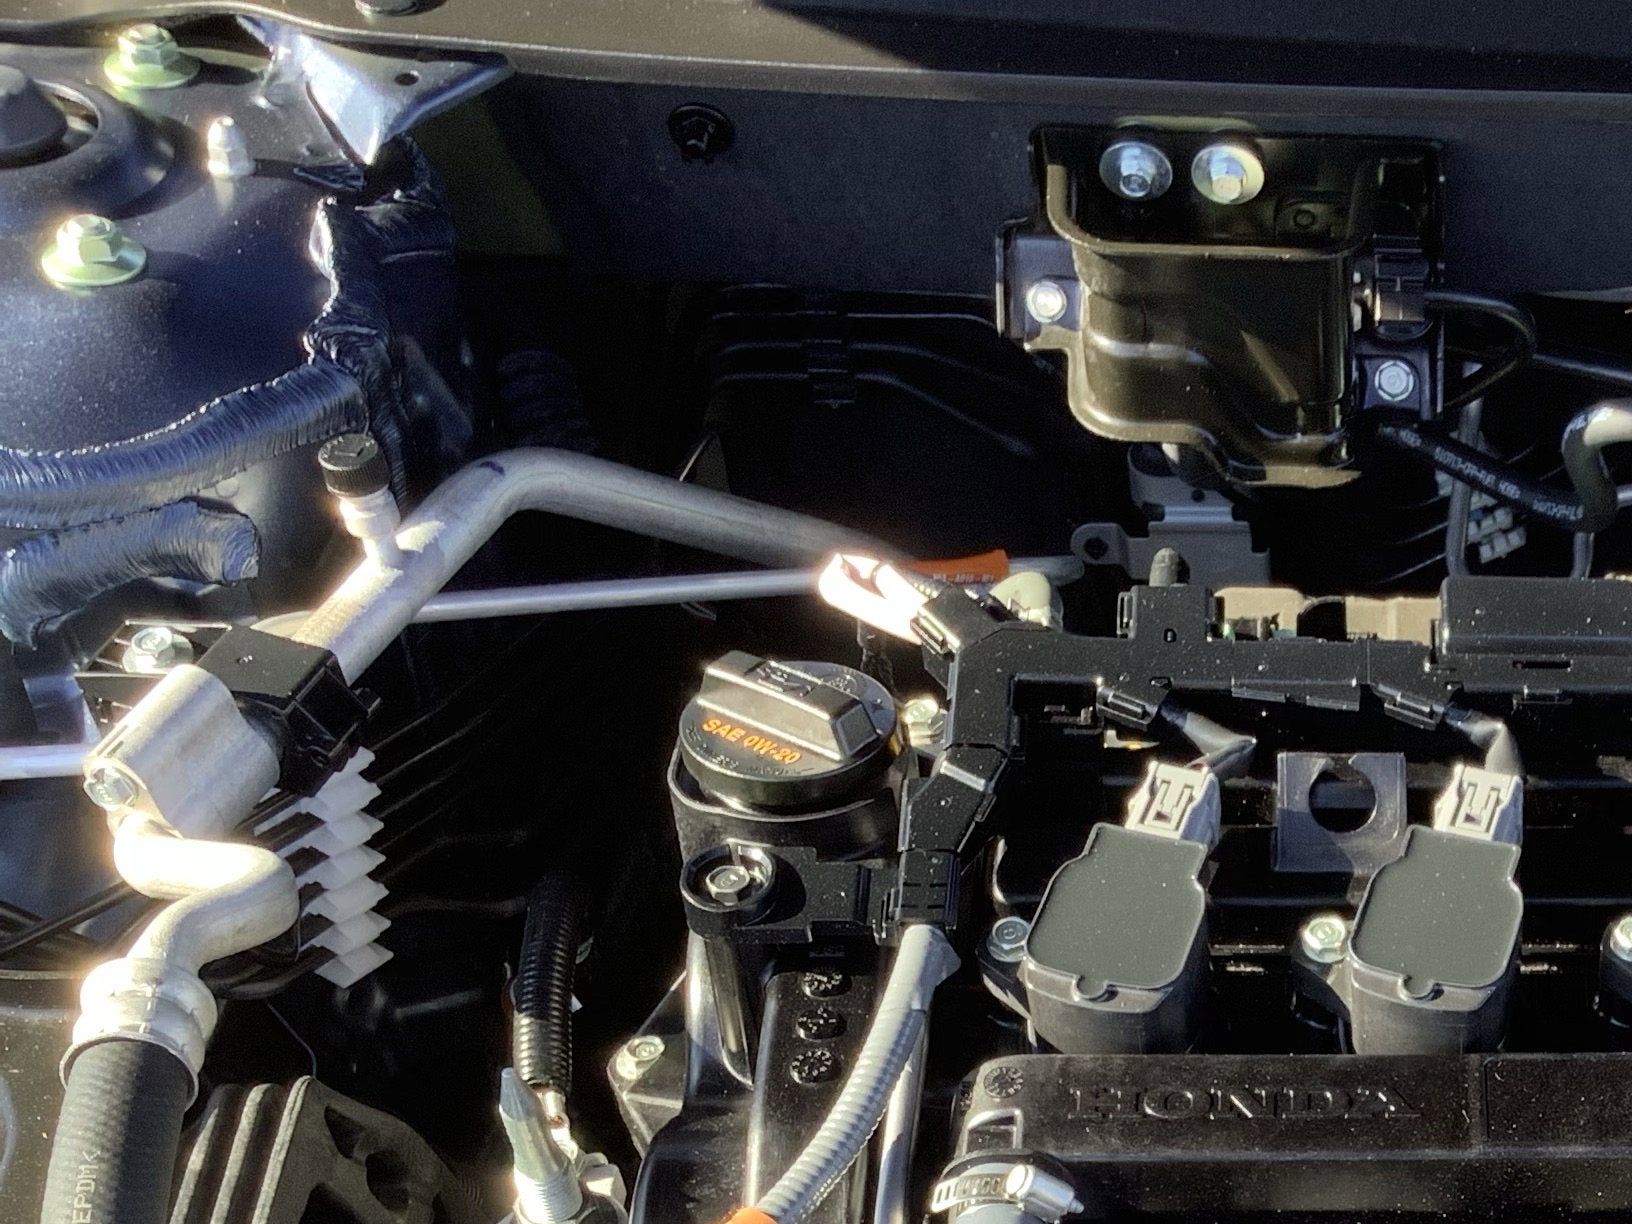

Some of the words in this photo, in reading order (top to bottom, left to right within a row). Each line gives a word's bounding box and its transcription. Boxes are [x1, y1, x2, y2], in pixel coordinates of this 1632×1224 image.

[702, 717, 746, 743] SAE
[743, 734, 802, 765] 0W-20
[1066, 1086, 1422, 1119] HONDA
